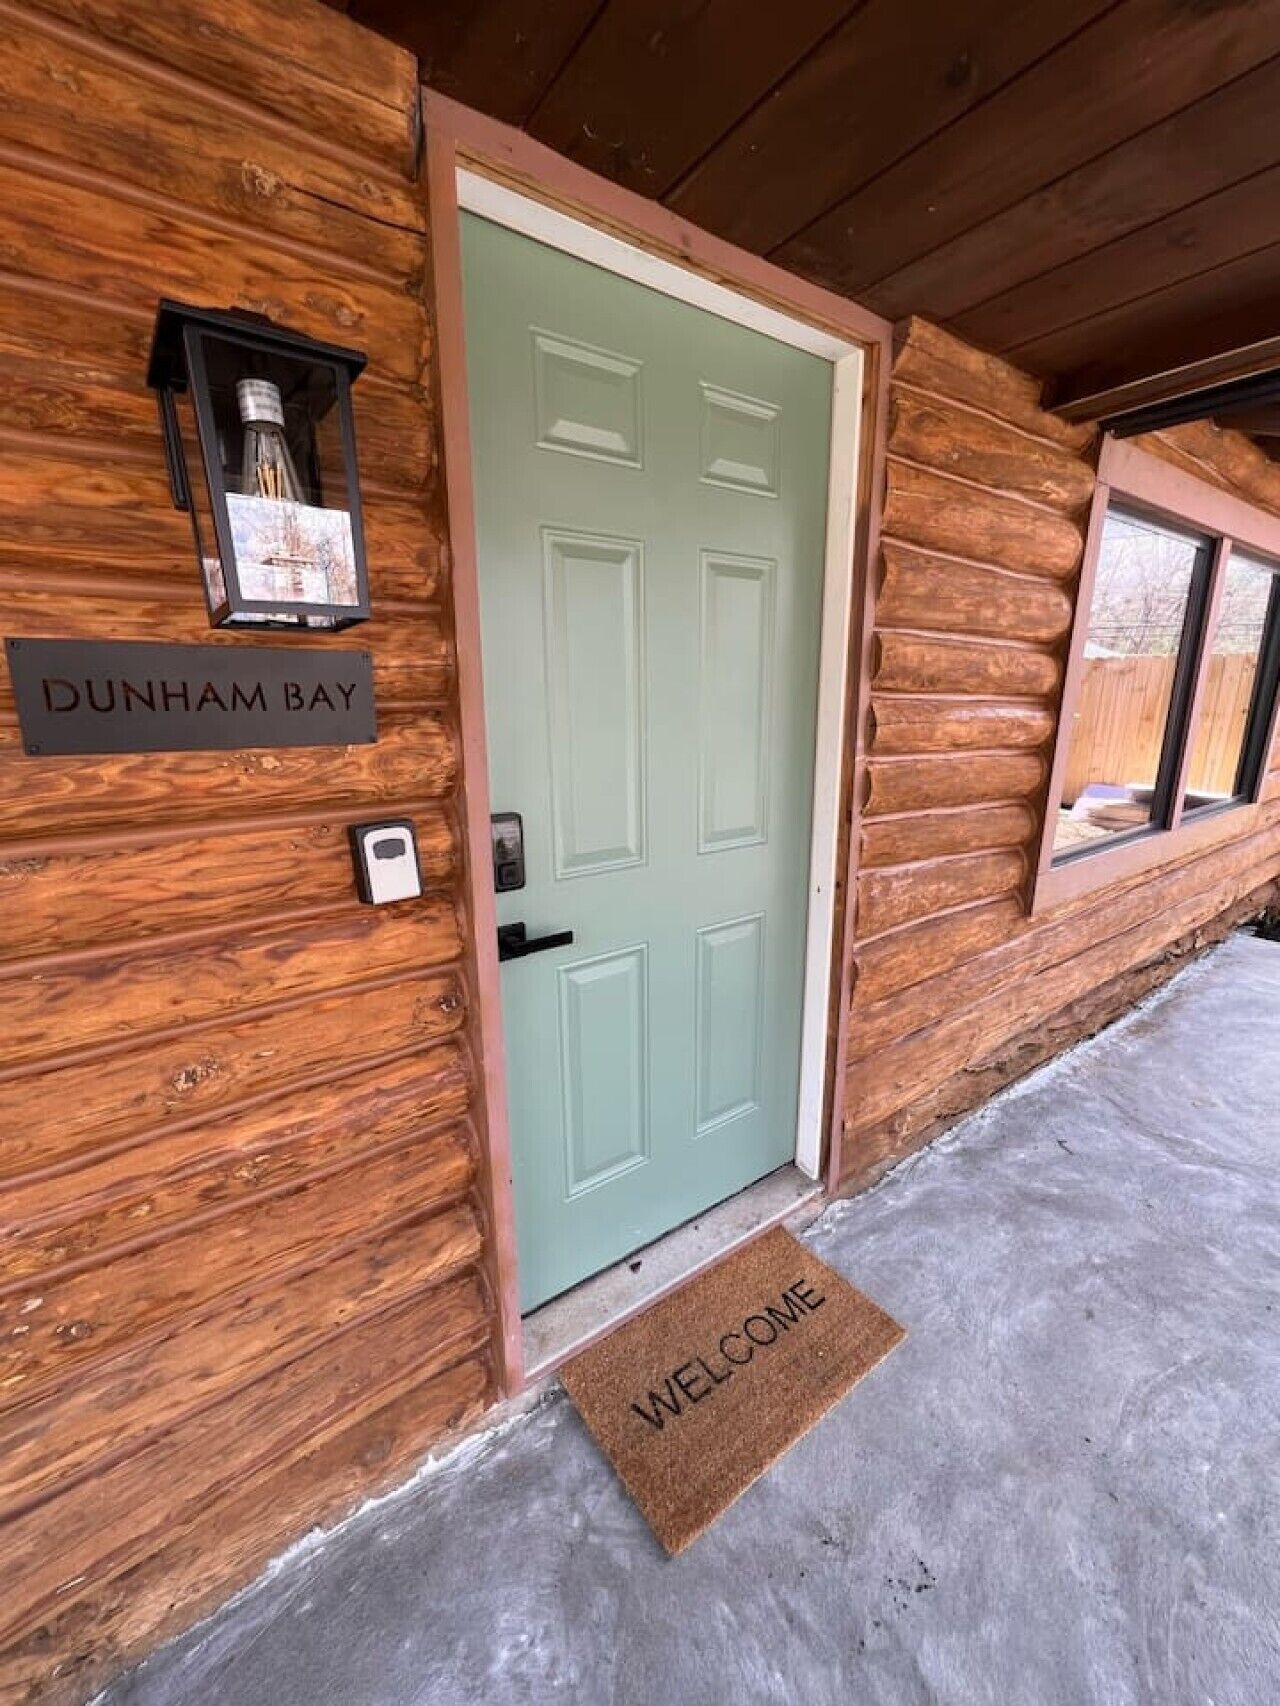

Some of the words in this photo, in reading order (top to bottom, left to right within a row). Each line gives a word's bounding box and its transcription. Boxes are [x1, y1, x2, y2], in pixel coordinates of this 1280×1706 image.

[42, 678, 267, 712] DUNHAM
[283, 682, 356, 711] BAY
[630, 1279, 826, 1430] WELCOME
